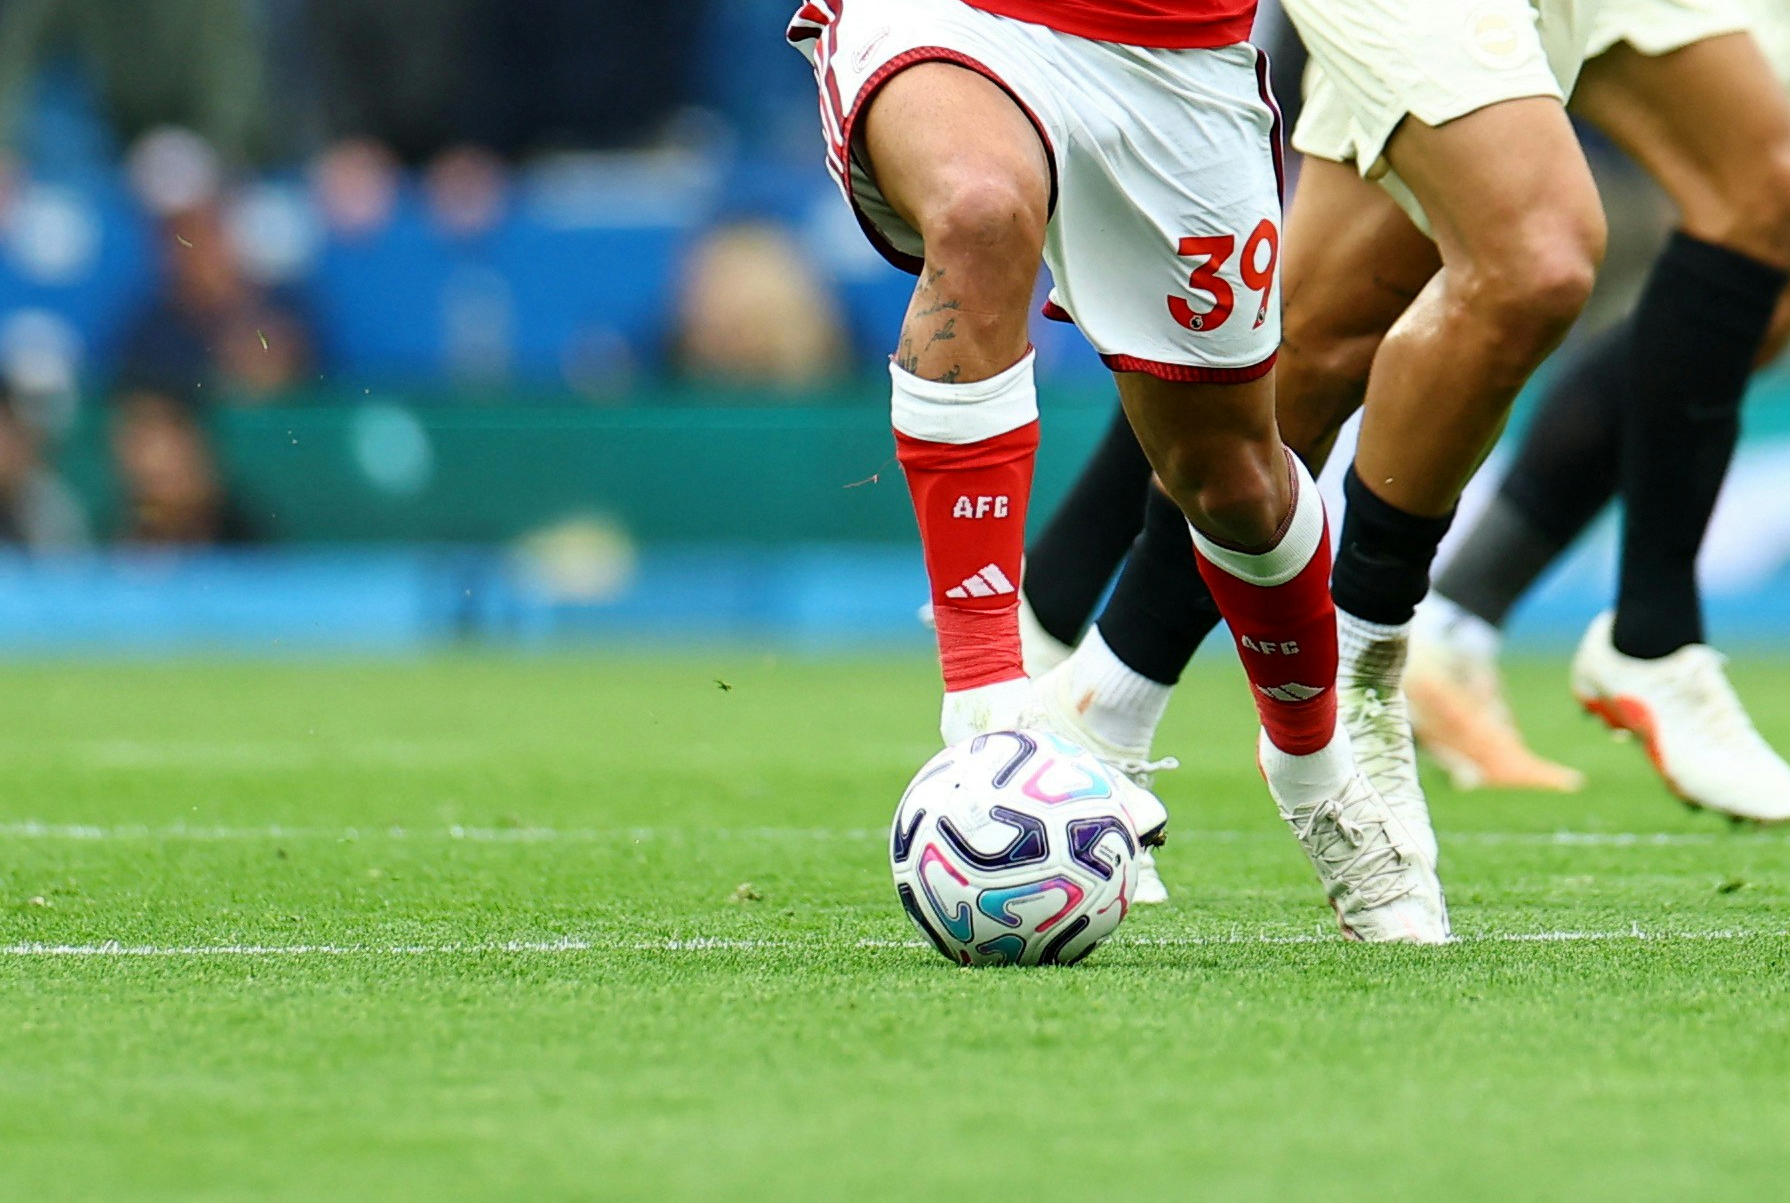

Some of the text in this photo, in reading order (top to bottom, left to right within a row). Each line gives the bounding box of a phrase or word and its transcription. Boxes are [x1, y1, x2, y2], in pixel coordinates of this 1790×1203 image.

[1167, 218, 1278, 332] 39
[952, 495, 1009, 519] AFC
[1241, 634, 1300, 656] AFC
